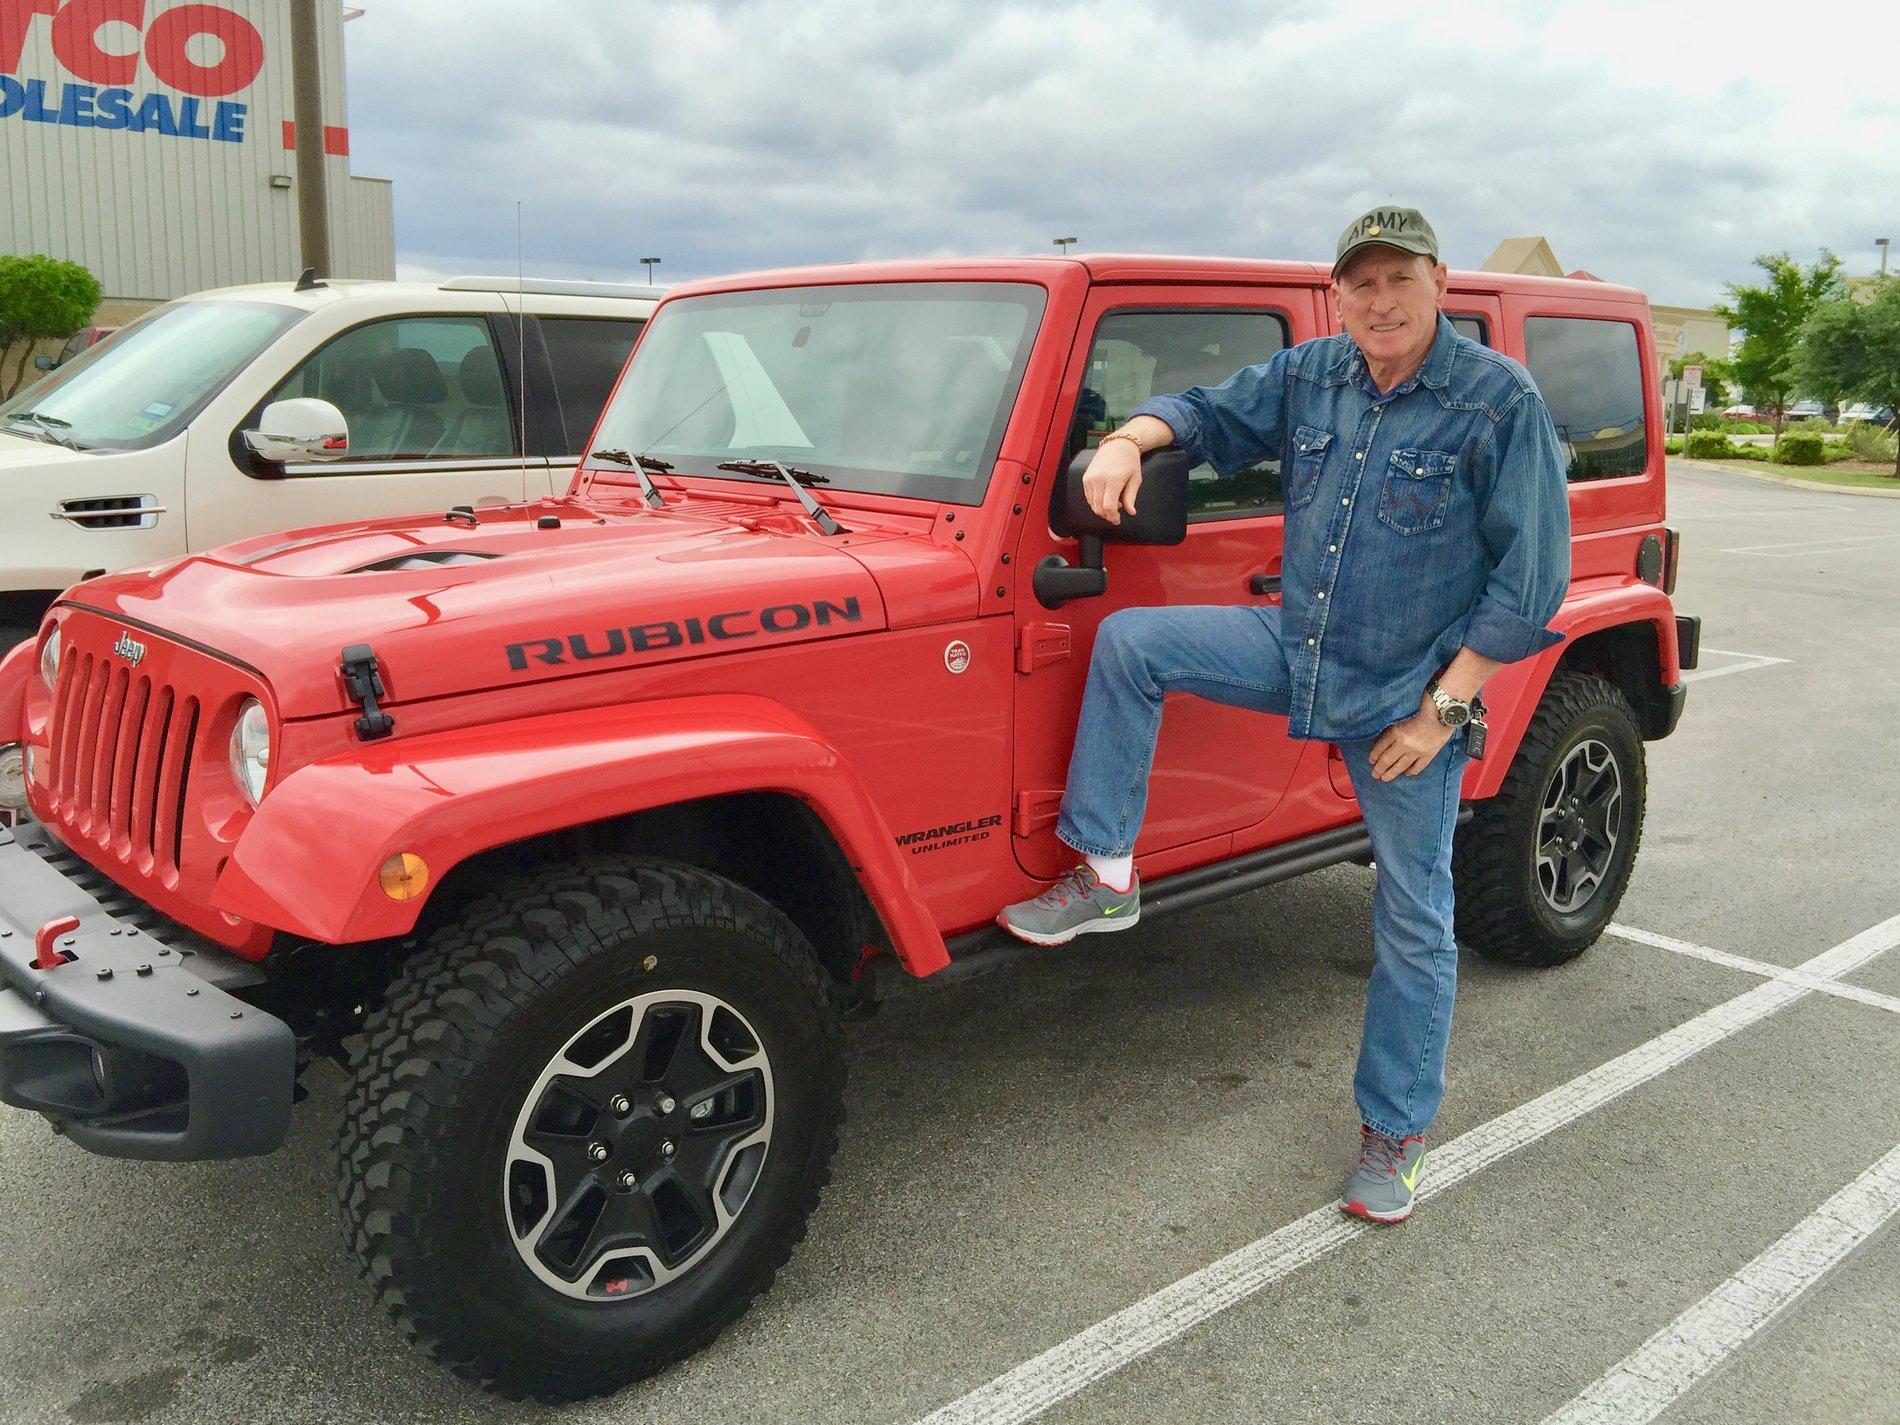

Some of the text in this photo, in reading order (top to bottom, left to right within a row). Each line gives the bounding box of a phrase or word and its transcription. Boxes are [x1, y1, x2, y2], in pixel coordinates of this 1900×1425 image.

[1348, 211, 1408, 245] ARMY
[114, 631, 146, 668] Jeep
[504, 597, 862, 671] RUBICON
[895, 815, 1002, 847] WRANGLER
[911, 832, 990, 855] UNLIMITED
